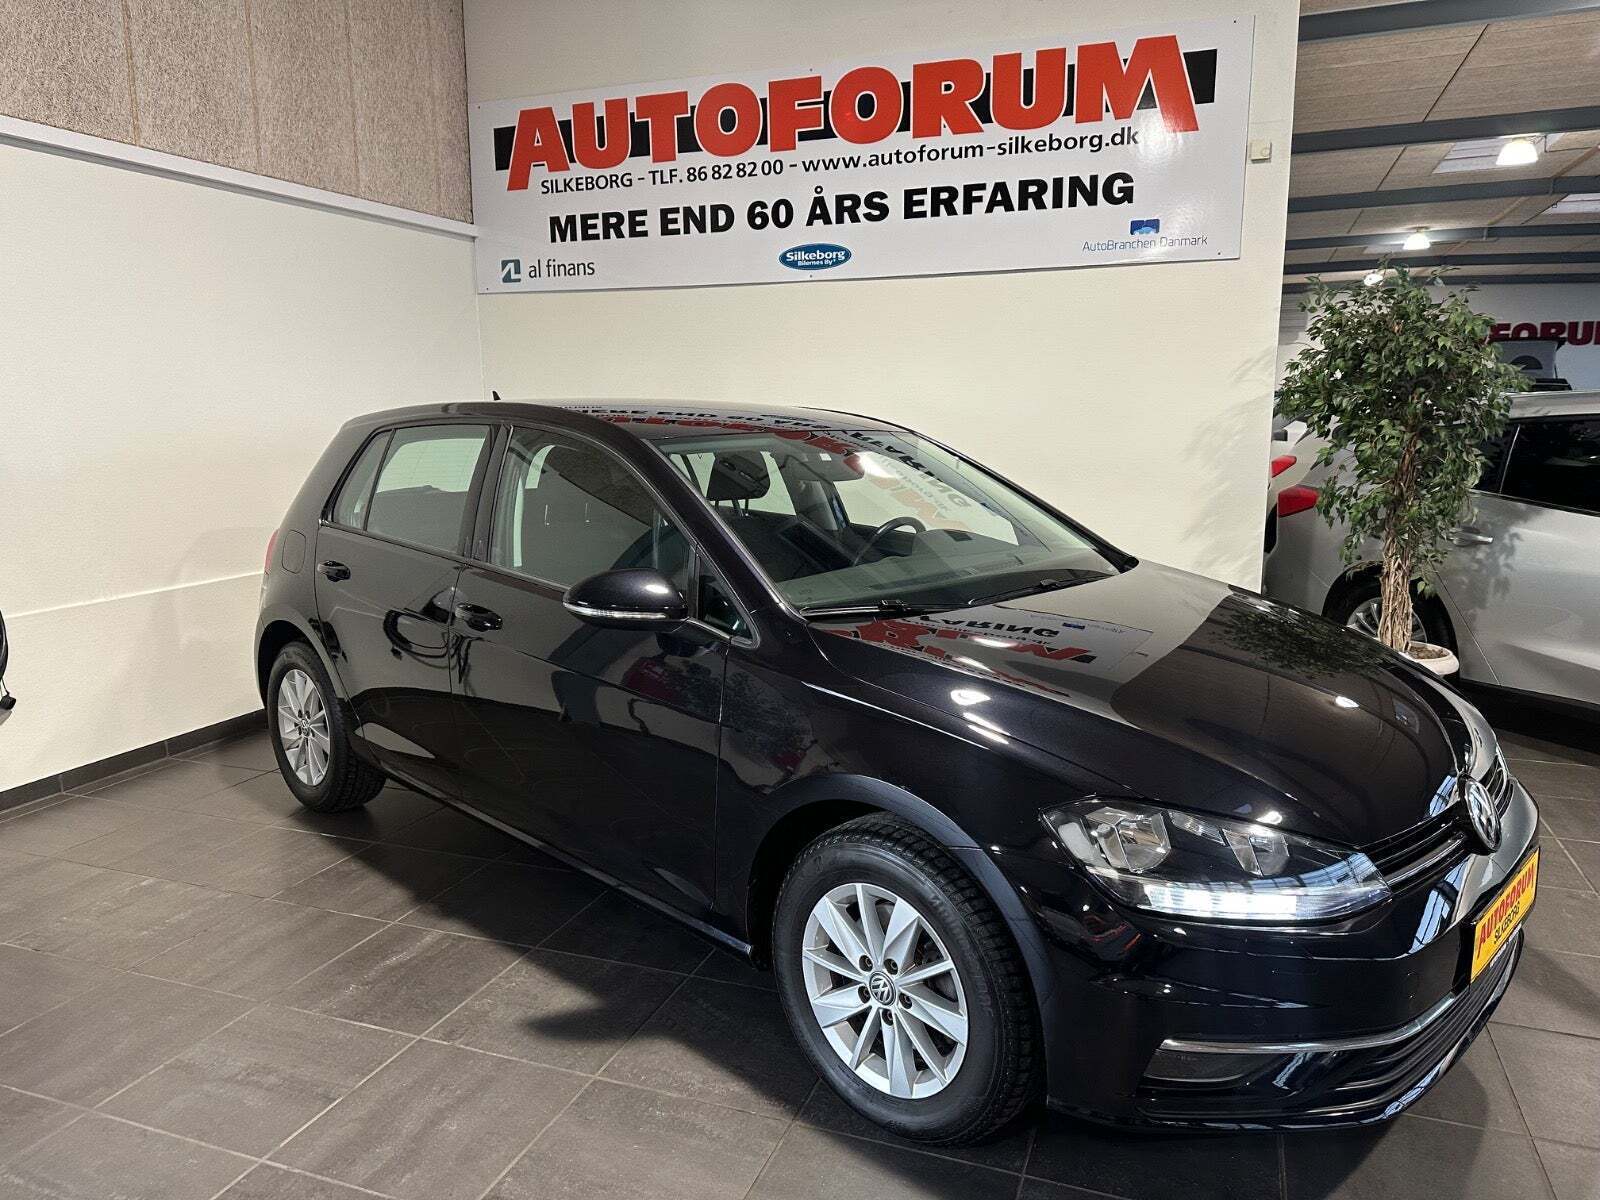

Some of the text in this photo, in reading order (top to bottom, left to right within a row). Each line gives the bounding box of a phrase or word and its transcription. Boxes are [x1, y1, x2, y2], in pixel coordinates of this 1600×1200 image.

[507, 34, 1200, 191] AUTOFORUM
[541, 173, 633, 194] SILKEBORG
[649, 168, 683, 185] TLF.
[802, 126, 1138, 172] www.autoforum-silkeborg.dk
[549, 172, 1134, 243] MERE END 60 ÅRS ERFARING
[528, 258, 596, 279] al finans
[786, 249, 846, 262] Silkeborg
[1082, 234, 1208, 252] AutoBranchen Danmark
[1476, 863, 1534, 960] AUTOFORUM
